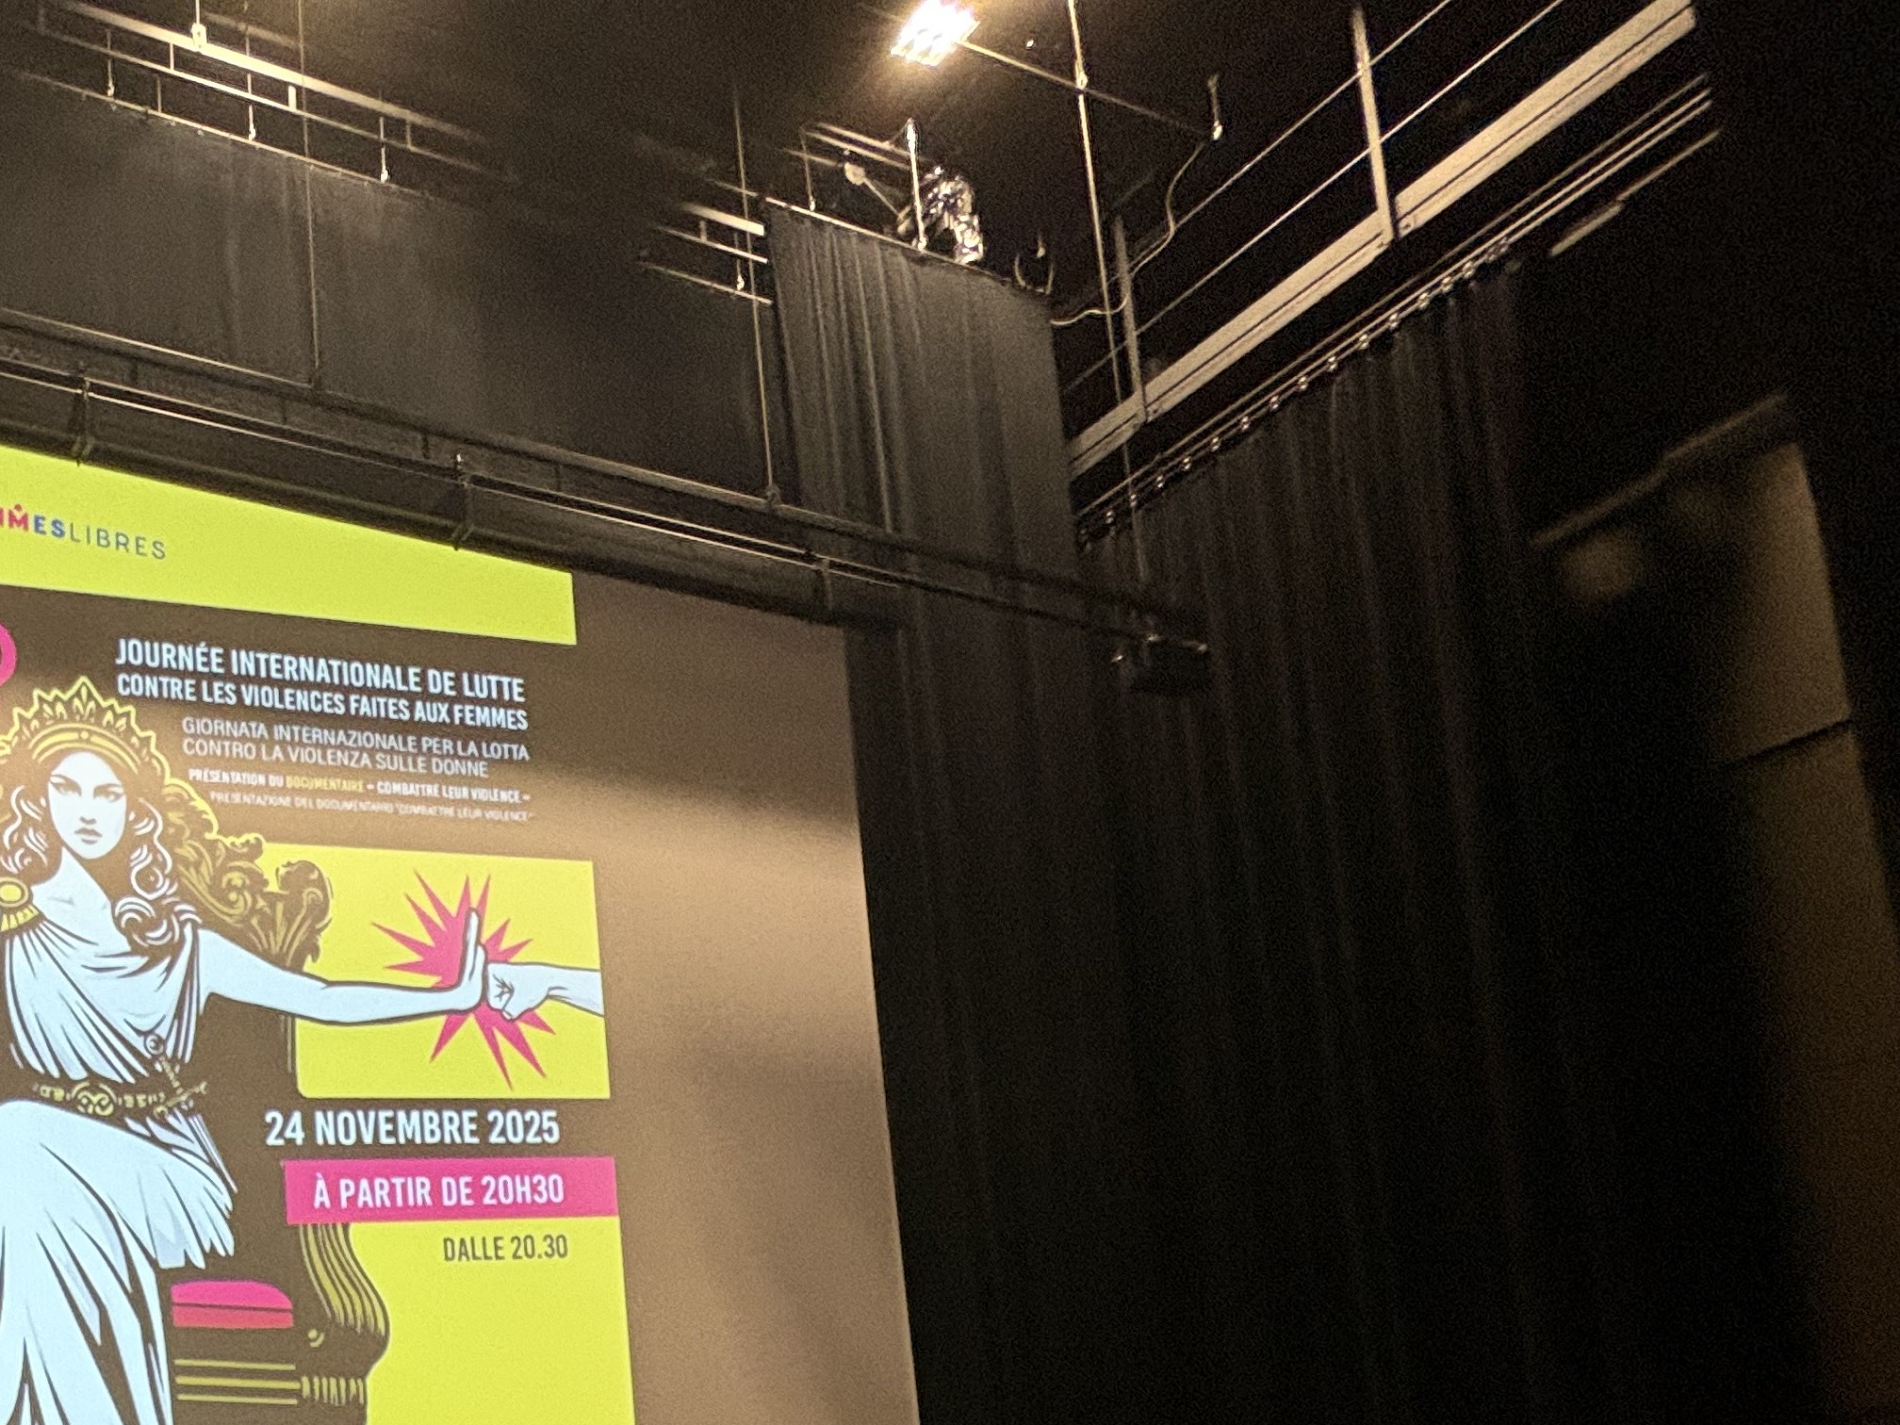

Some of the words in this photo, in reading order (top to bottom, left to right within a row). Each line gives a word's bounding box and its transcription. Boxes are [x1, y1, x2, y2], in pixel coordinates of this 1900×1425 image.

[115, 637, 225, 674] JOURNÉE
[231, 648, 422, 693] INTERNATIONALE
[427, 668, 457, 697] DE
[462, 672, 526, 703] LUTTE
[117, 672, 197, 701] CONTRE
[201, 679, 237, 706] LES
[241, 684, 345, 716] VIOLENCES
[350, 694, 410, 721] FAITES
[414, 700, 450, 724] AUX
[453, 704, 529, 731] FEMMES
[182, 716, 269, 740] GIORNATA
[273, 724, 418, 752] INTERNAZIONALE
[421, 736, 454, 755] PER
[457, 740, 480, 758] LA
[482, 741, 530, 762] LOTTA
[182, 737, 257, 761] CONTRO
[261, 743, 285, 762] LA
[287, 746, 372, 770] VIOLENZA
[375, 753, 427, 774] SULLE
[431, 757, 489, 779] DONNE
[268, 774, 284, 788] DU
[377, 780, 440, 798] COMBATTRE
[442, 784, 470, 800] LEUR
[470, 786, 521, 804] VIOLENCE
[264, 1109, 305, 1147] 24
[314, 1109, 480, 1146] NOVEMBRE
[487, 1109, 561, 1145] 2025
[313, 1172, 331, 1209] À
[339, 1176, 432, 1209] PARTIR
[441, 1175, 475, 1207] DE
[481, 1173, 565, 1205] 20H30
[443, 1235, 506, 1262] DALLE
[510, 1234, 569, 1261] 20.30
